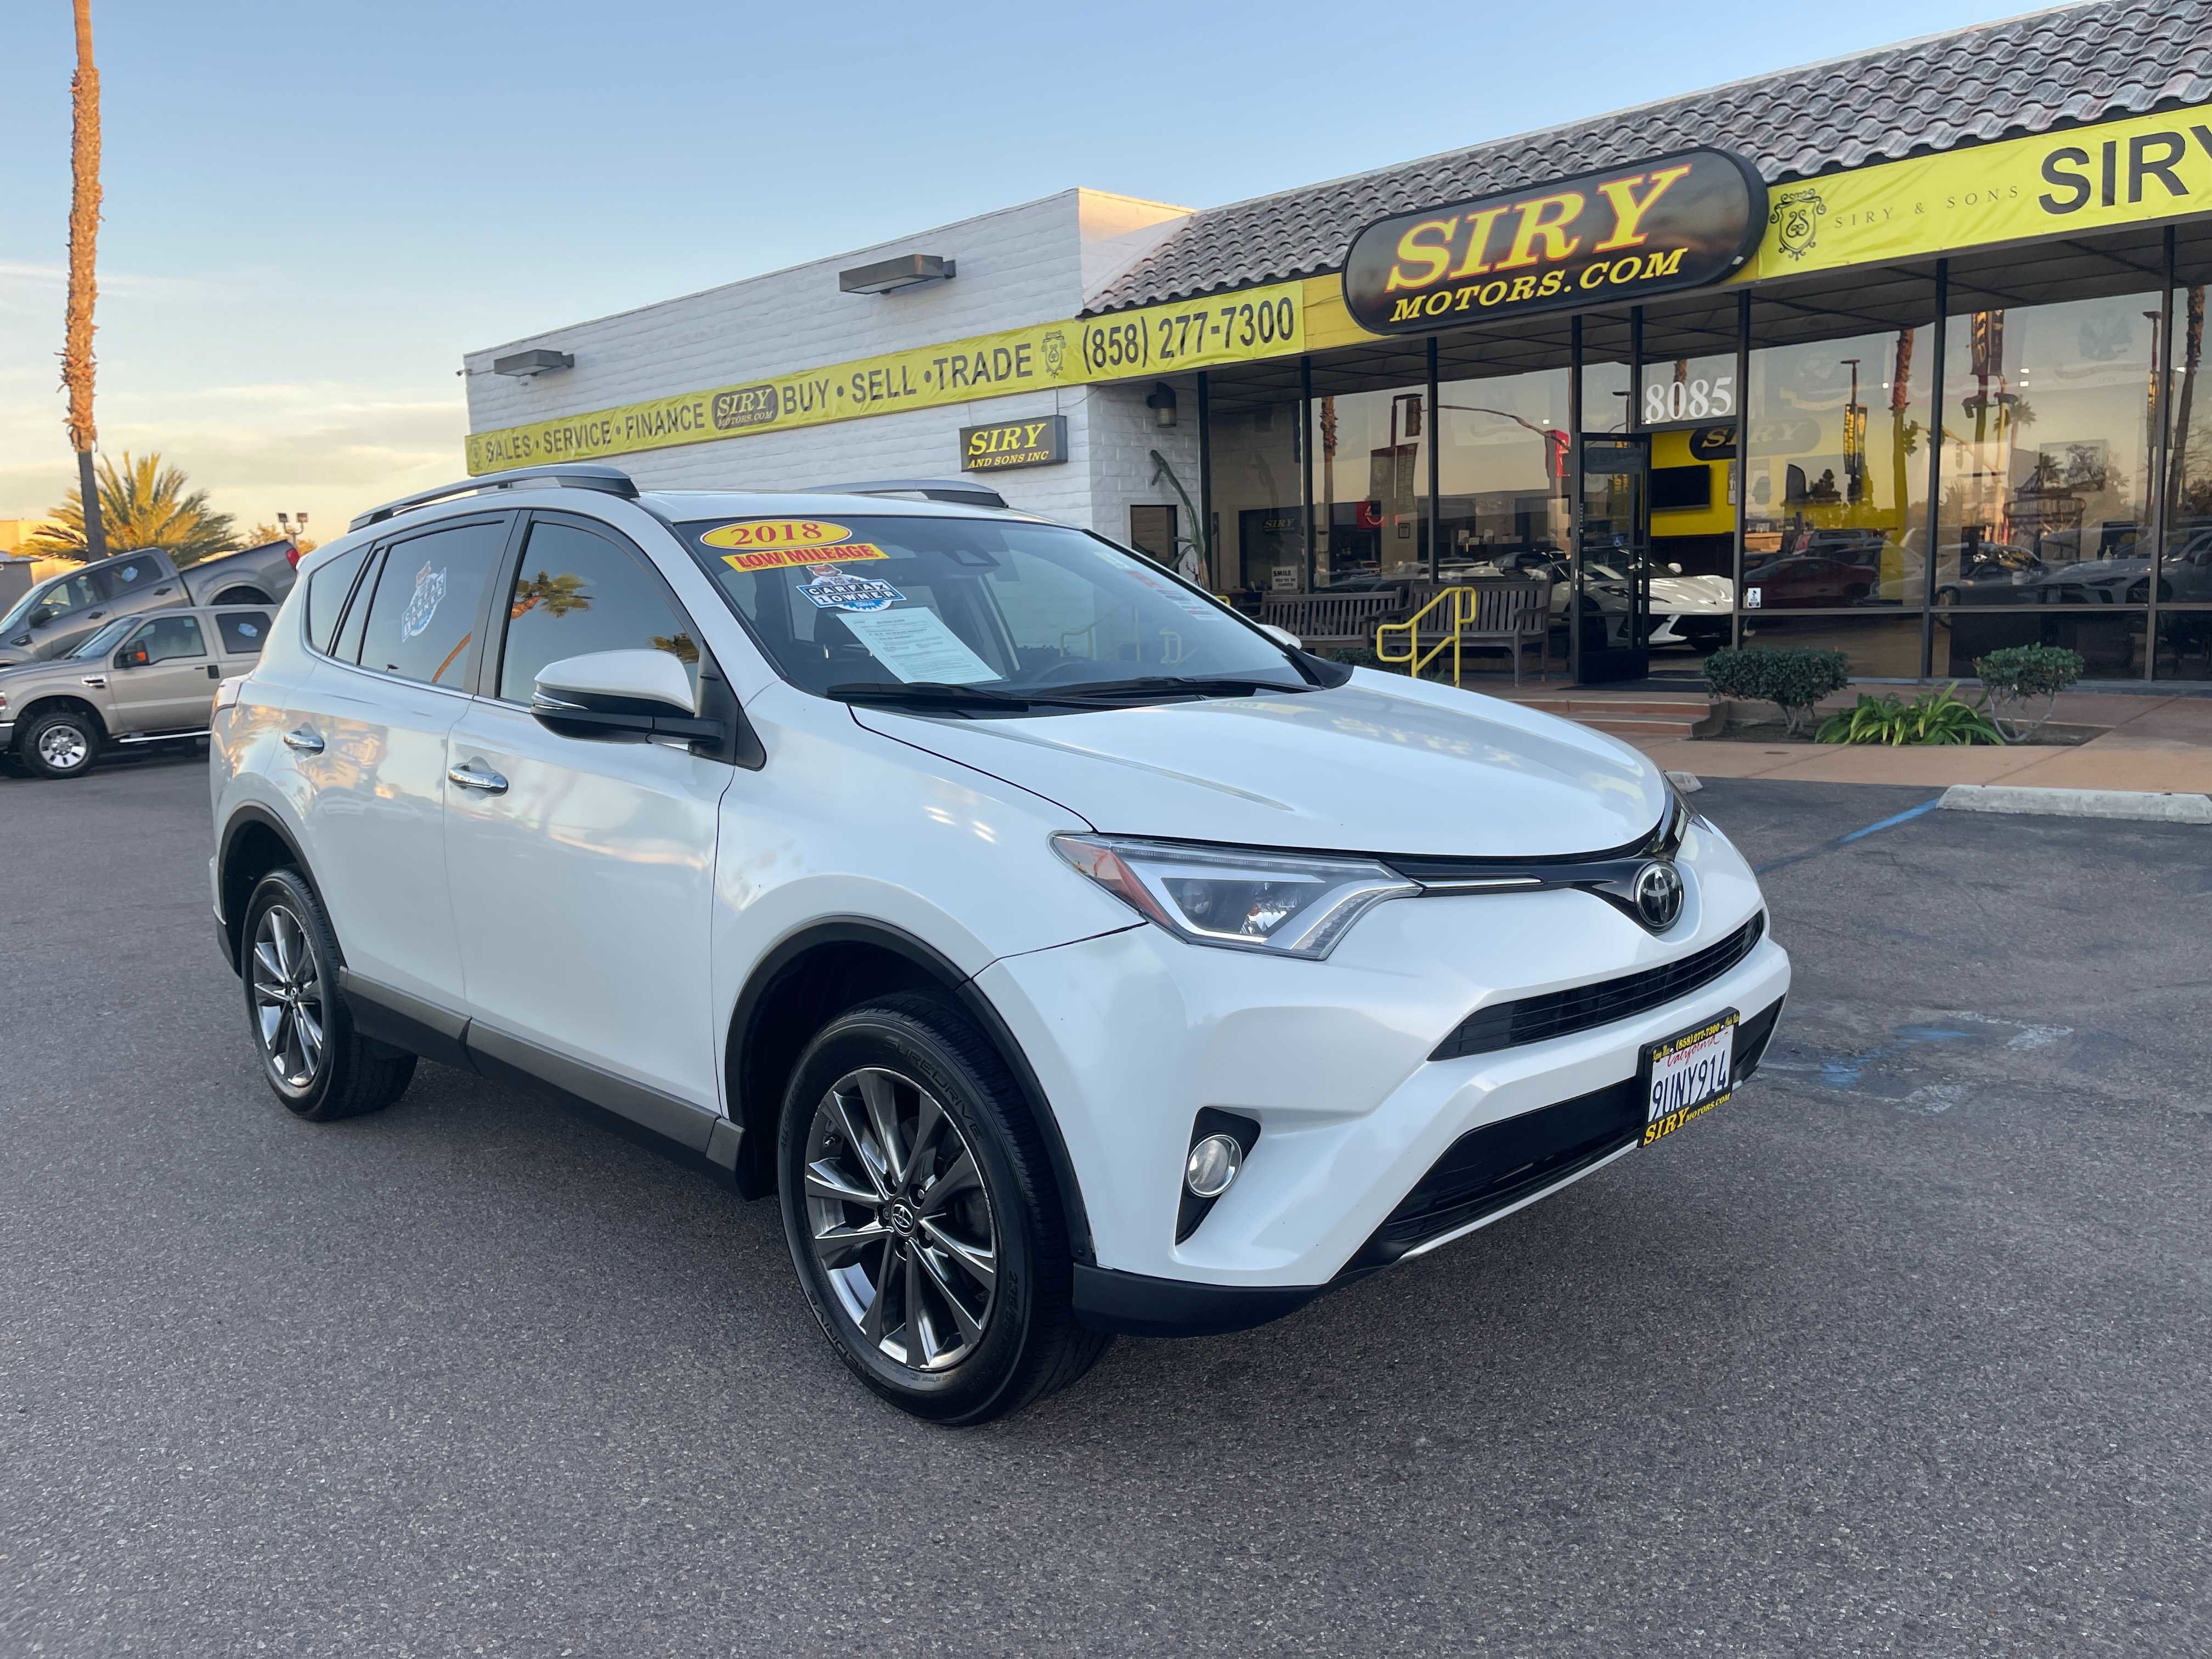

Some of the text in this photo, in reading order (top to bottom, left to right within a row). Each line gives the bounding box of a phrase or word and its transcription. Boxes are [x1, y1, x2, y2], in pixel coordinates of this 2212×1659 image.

[1835, 185, 2018, 229] SIRY & SONS
[1385, 163, 1692, 293] SIRY
[1390, 247, 1689, 323] MOTORS.COM
[1082, 297, 1294, 375] (858) 277-7300
[783, 343, 1033, 415] BUY SELL TRADE
[717, 388, 773, 417] SIRY
[1646, 376, 1732, 422] 8085
[486, 403, 705, 462] SALES SERVICE FINANCE
[718, 411, 773, 427] MOTORS.COM
[968, 423, 1047, 456] SIRY
[968, 450, 1049, 469] AND SONS INC
[731, 523, 822, 545] 2018
[735, 545, 878, 569] LOW MILEAGE
[808, 583, 888, 595] CARFAX
[831, 591, 896, 602] OWNER
[1668, 1035, 1720, 1067] California
[1651, 1050, 1726, 1121] 9UNY914
[1686, 1093, 1731, 1122] MOTORS.COM
[1643, 1107, 1690, 1146] SIRY
